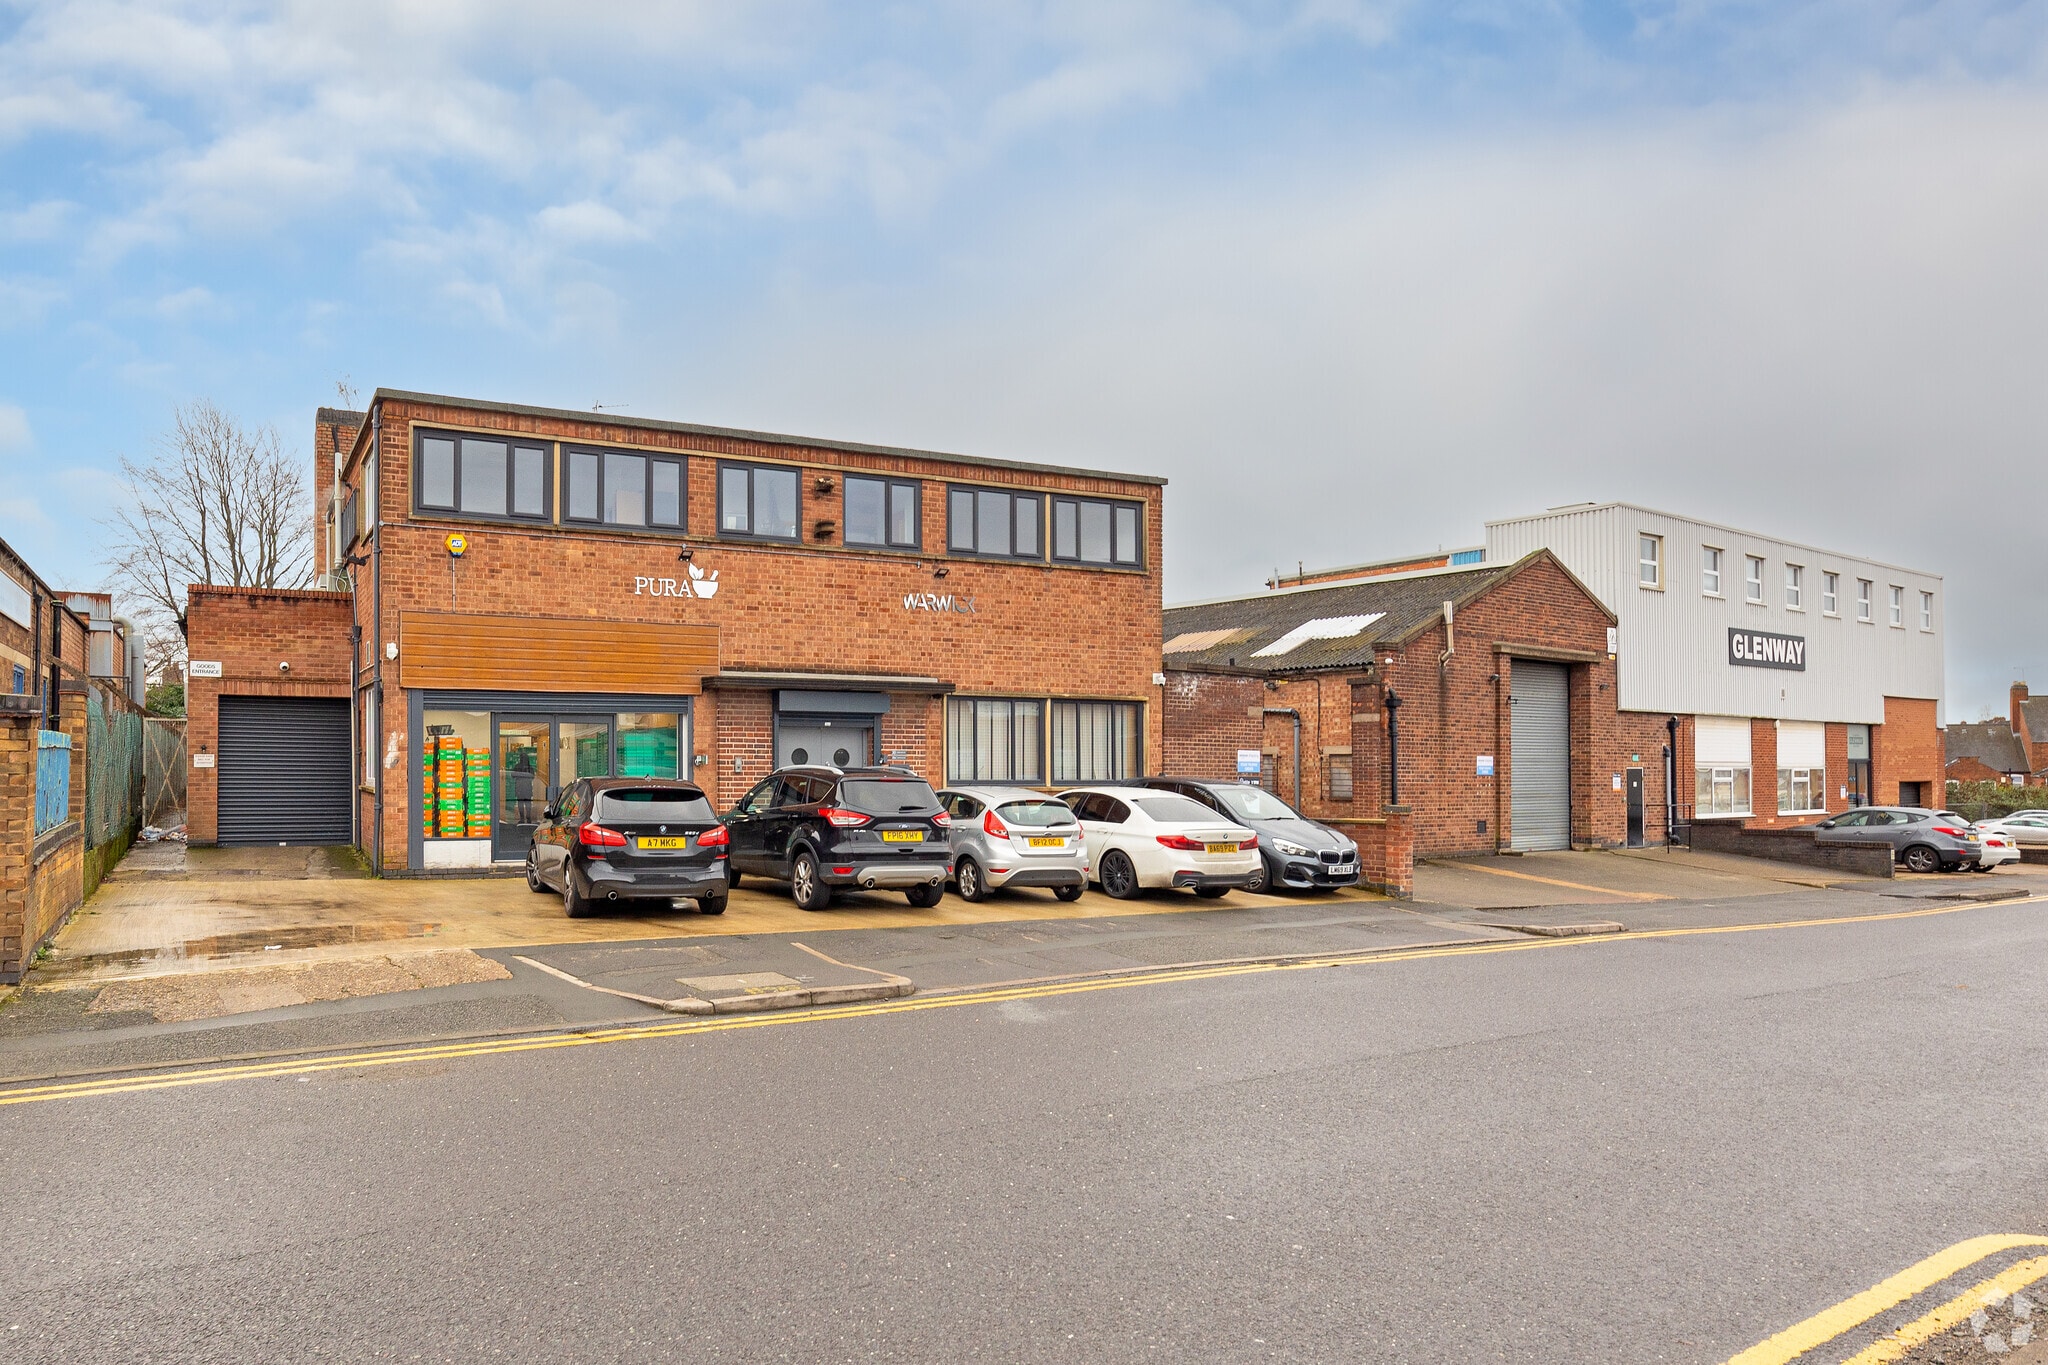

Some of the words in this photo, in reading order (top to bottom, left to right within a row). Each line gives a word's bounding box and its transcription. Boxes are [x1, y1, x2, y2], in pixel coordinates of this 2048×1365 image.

[634, 576, 694, 598] PURA
[903, 592, 977, 614] WARWICK
[1732, 633, 1804, 664] GLENWAY
[647, 838, 659, 848] A7
[887, 831, 904, 840] FP16
